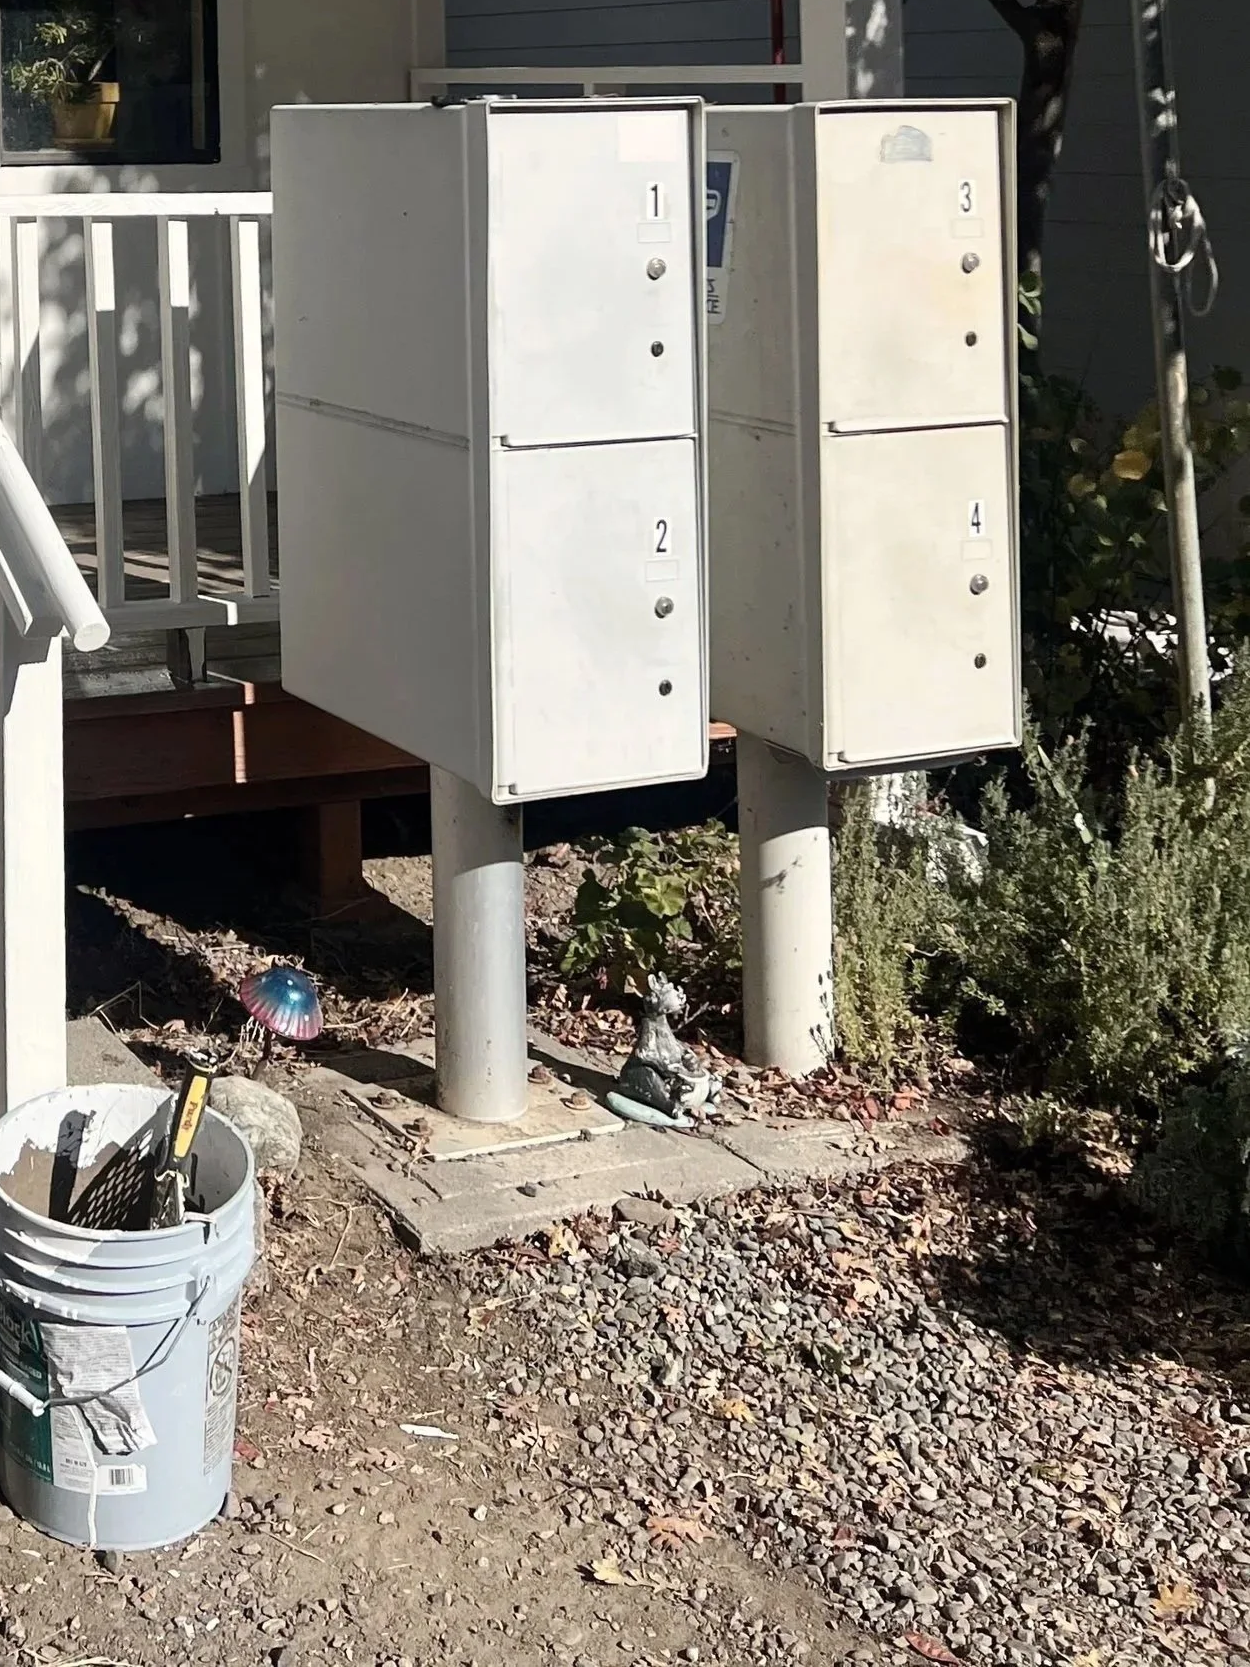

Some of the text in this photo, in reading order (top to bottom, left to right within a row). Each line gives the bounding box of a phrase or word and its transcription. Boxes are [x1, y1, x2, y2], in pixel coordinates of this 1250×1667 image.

[650, 184, 658, 217] 1
[960, 181, 972, 213] 3
[971, 502, 981, 534] 4
[656, 519, 667, 553] 2
